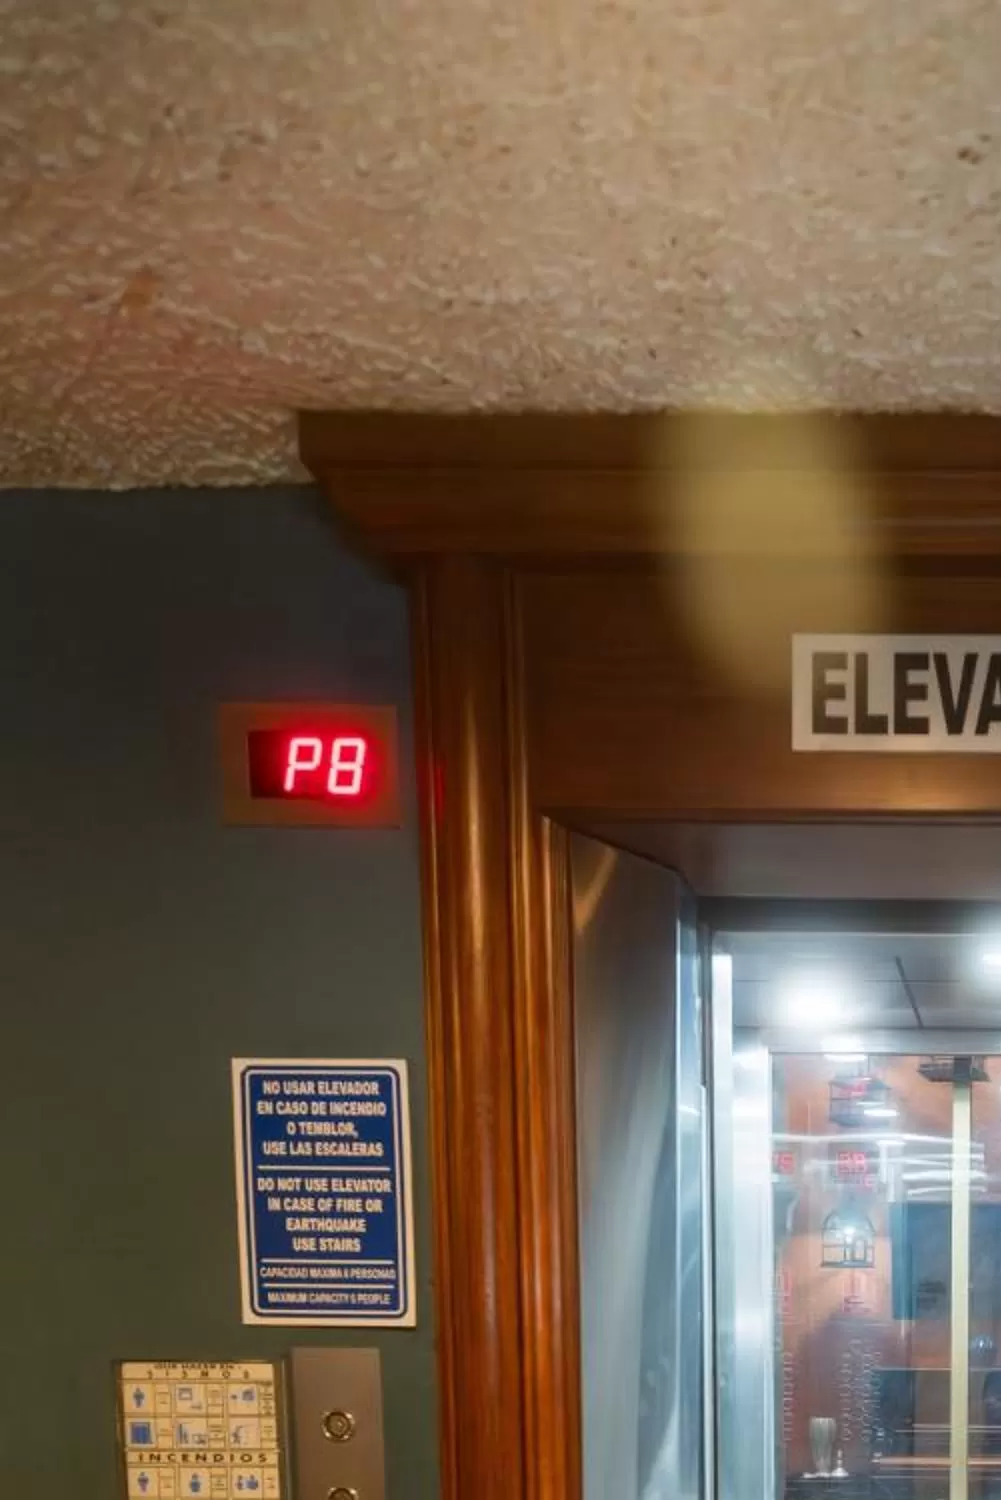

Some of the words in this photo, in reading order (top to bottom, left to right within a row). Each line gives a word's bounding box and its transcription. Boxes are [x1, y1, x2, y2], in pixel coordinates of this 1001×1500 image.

[283, 736, 366, 795] P8
[262, 1080, 280, 1095] NO
[283, 1080, 315, 1095] USAR
[318, 1081, 379, 1096] ELEVADOR
[257, 1101, 273, 1115] EN
[276, 1101, 308, 1115] CASO
[311, 1102, 327, 1116] DE
[329, 1102, 387, 1116] INCENDIO
[287, 1121, 297, 1135] O
[299, 1121, 359, 1139] TEMBLOR,
[263, 1141, 287, 1156] USE
[289, 1141, 313, 1156] LAS
[315, 1142, 384, 1157] ESCALERAS
[257, 1177, 275, 1191] DO
[277, 1177, 301, 1191] NOT
[305, 1178, 328, 1192] USE
[331, 1178, 392, 1193] ELEVATOR
[267, 1197, 281, 1211] IN
[283, 1197, 315, 1212] CASE
[317, 1198, 333, 1212] OF
[336, 1198, 363, 1213] FIRE
[365, 1199, 383, 1213] OR
[286, 1217, 367, 1232] EARTHQUAKE
[292, 1237, 317, 1251] USE
[319, 1238, 361, 1252] STAIRS
[260, 1267, 308, 1279] CAPACIDAD
[138, 1453, 268, 1463] INCENDIOS
